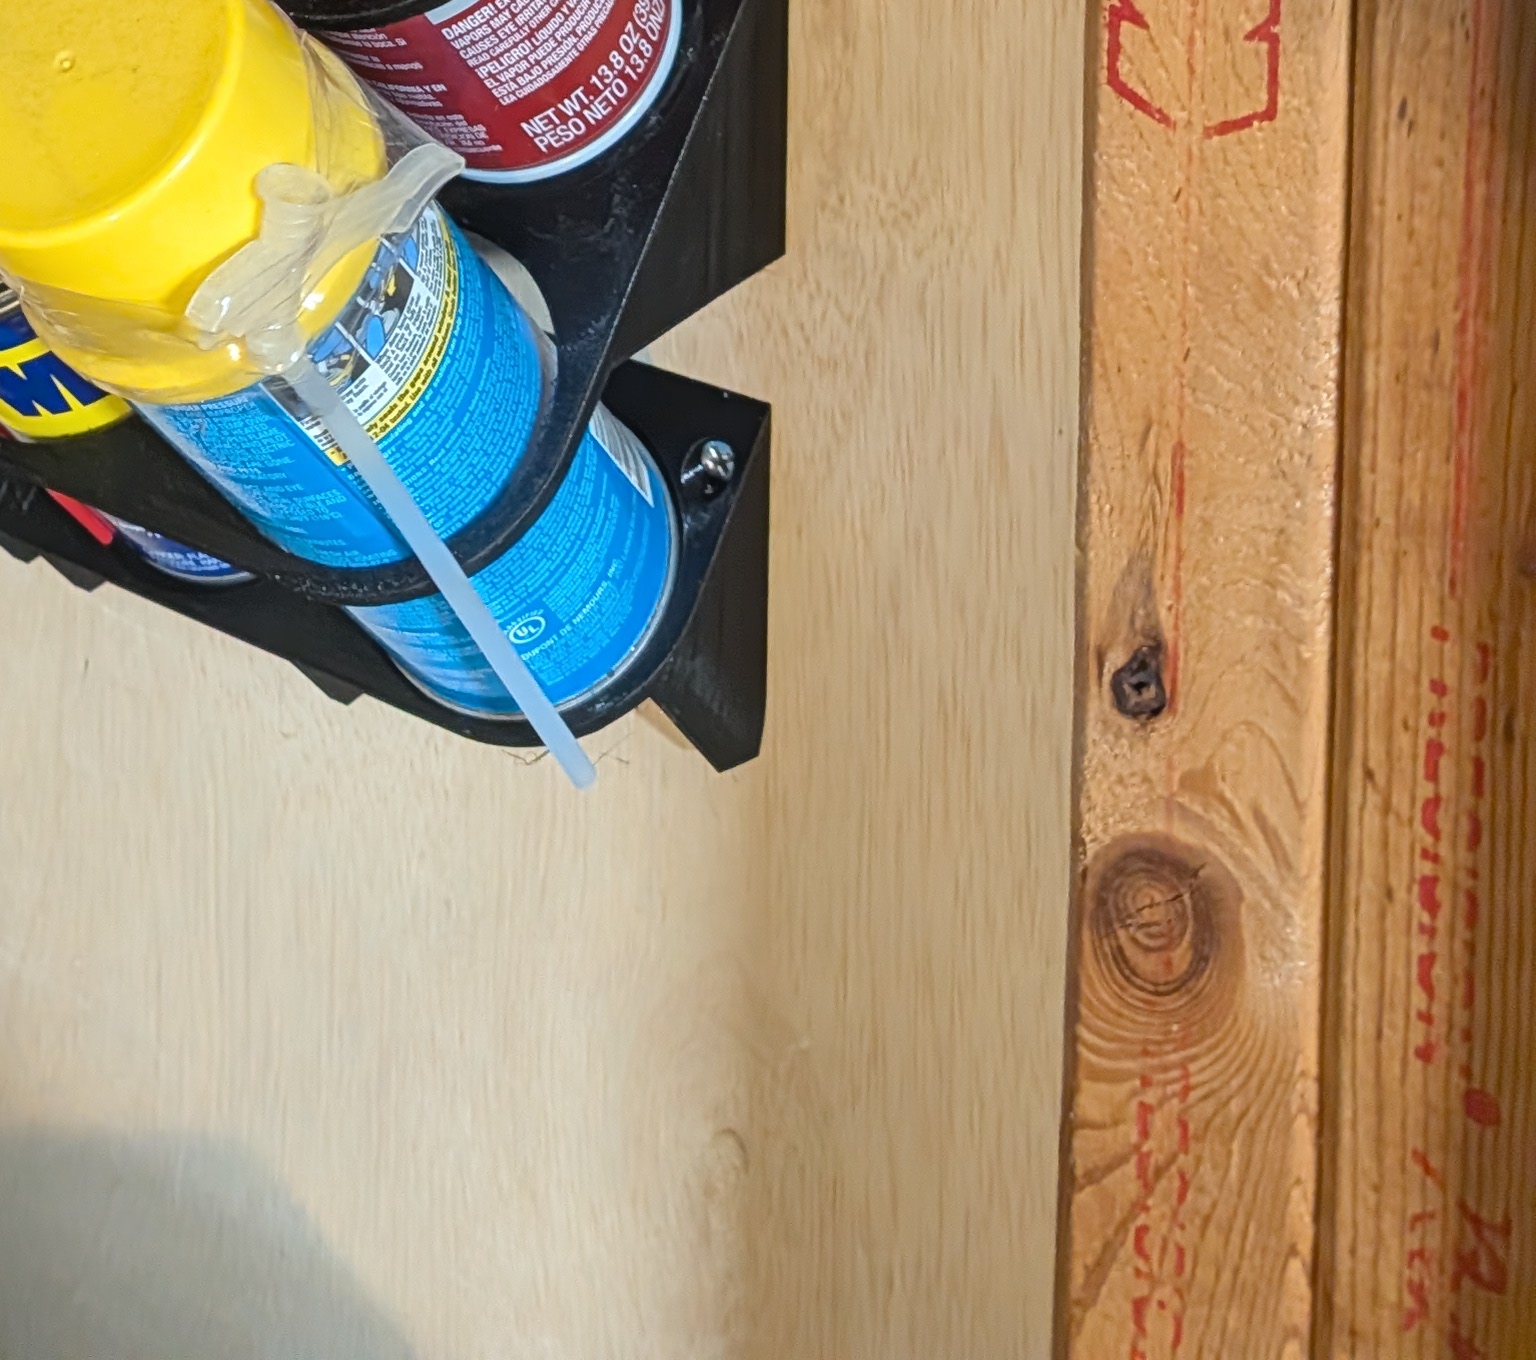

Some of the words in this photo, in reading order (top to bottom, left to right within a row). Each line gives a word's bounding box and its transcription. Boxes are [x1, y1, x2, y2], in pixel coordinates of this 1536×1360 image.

[441, 1, 498, 40] DANGER!
[450, 23, 492, 50] VAPORS
[488, 8, 512, 29] MAY
[459, 34, 499, 60] CAUSES
[496, 20, 518, 39] EYE
[466, 50, 491, 67] READ
[488, 25, 531, 56] CAREFULLY
[528, 4, 552, 28] OTHER
[474, 38, 534, 79] ¡PELIGRO!
[529, 10, 565, 46] LÍQUIDO
[560, 3, 570, 15] Y
[483, 75, 499, 89] EL
[495, 58, 530, 83] VAPOR
[527, 36, 558, 64] PUEDE
[491, 78, 519, 98] ESTÁ
[515, 64, 543, 86] BAJO
[540, 32, 579, 70] PRESIÓN.
[498, 93, 518, 105] LEA
[514, 47, 579, 98] CUIDADOSAMENTE
[576, 25, 598, 52] OTRAS
[519, 103, 568, 140] NET
[558, 83, 594, 117] WT.
[588, 45, 627, 93] 13.8
[616, 19, 641, 55] OZ
[535, 114, 588, 156] PESO
[582, 75, 631, 126] NETO
[621, 38, 657, 84] 13.8
